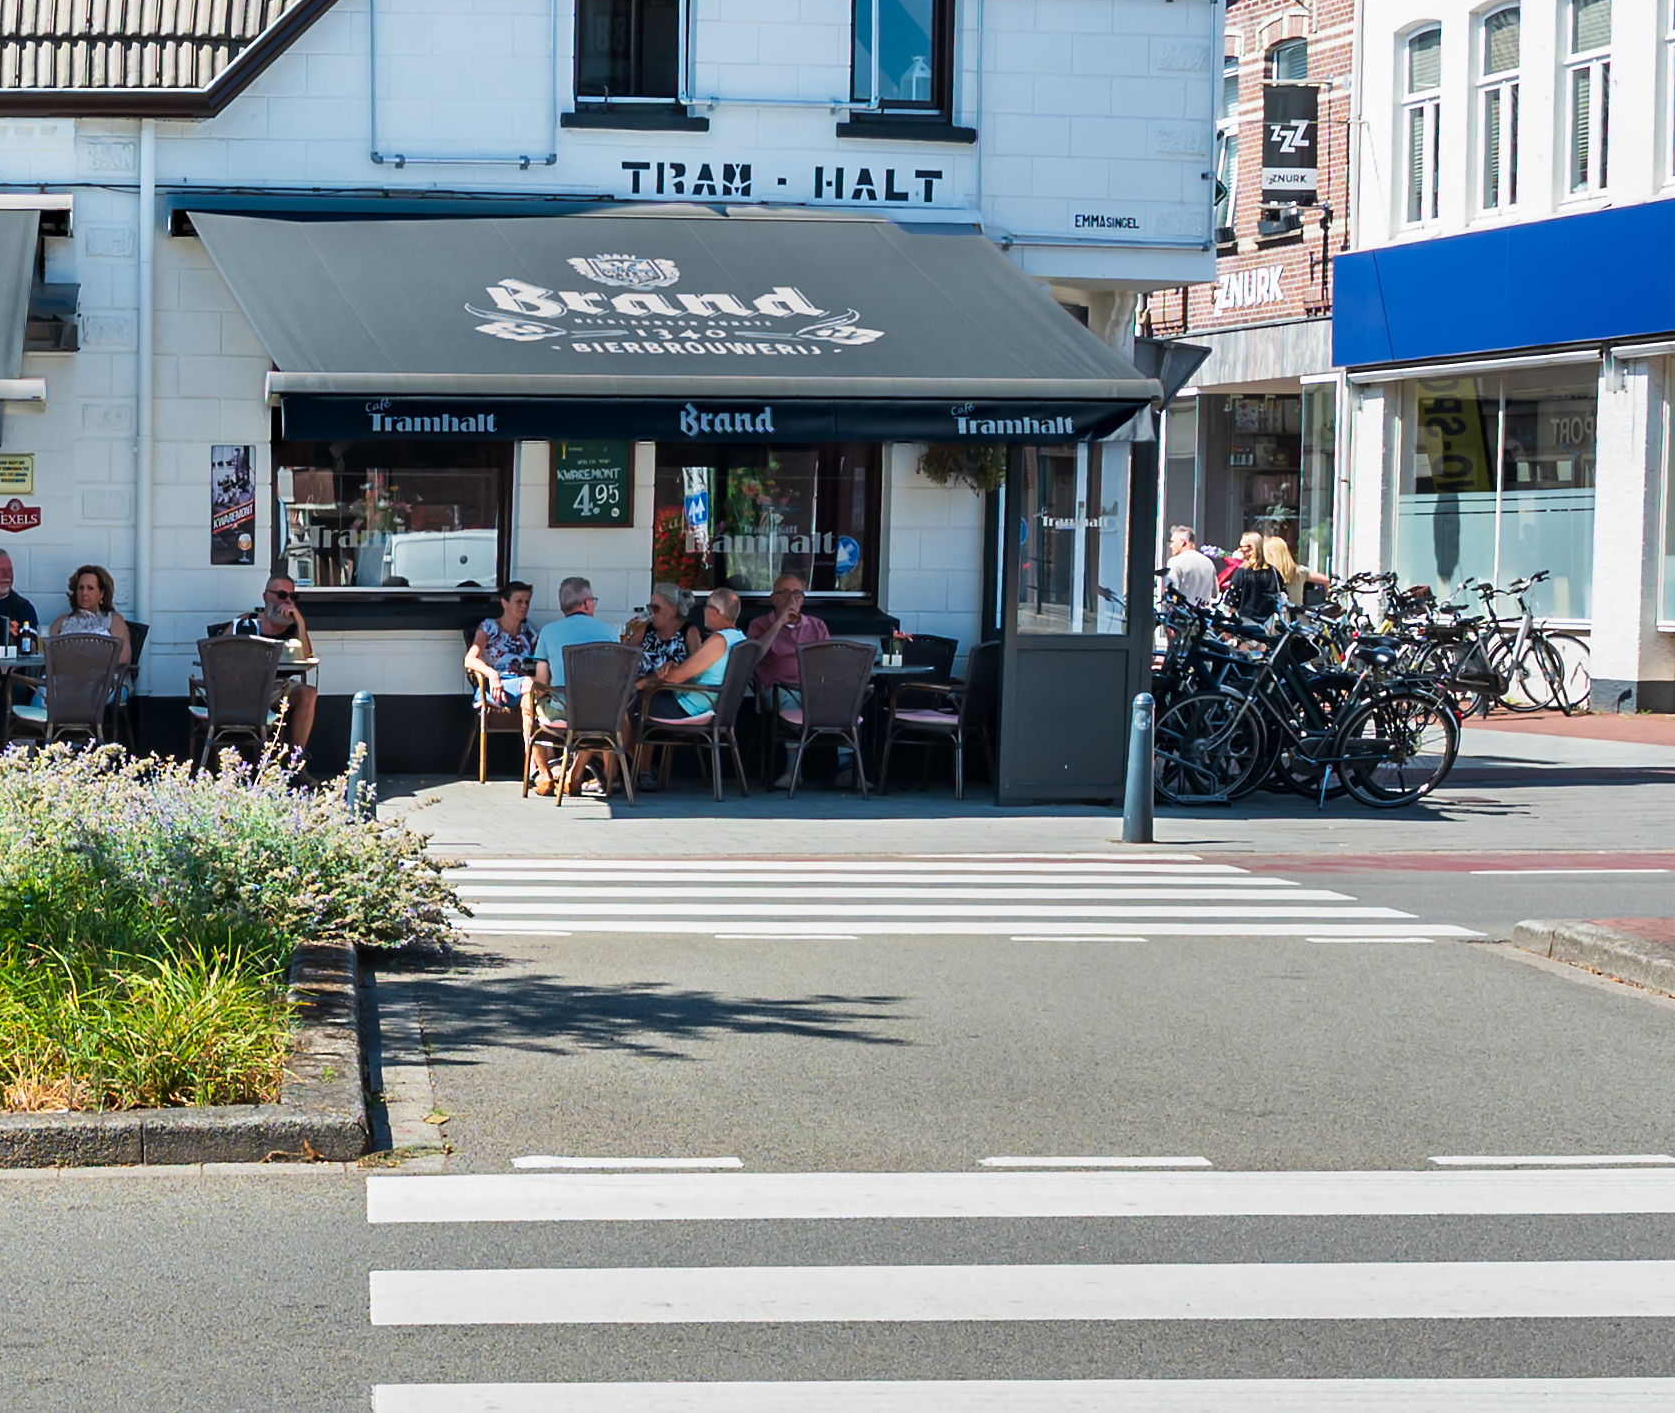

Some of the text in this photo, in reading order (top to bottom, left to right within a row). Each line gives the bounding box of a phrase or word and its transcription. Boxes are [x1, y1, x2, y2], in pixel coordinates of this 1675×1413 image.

[621, 161, 943, 203] TRAM HALT
[1074, 214, 1140, 229] EMMASINGEL
[485, 278, 830, 319] Brand
[635, 329, 729, 340] 1340
[571, 342, 823, 356] BIERBROUWERIJ
[368, 413, 498, 432] Tramhalt
[679, 403, 776, 438] Brand
[953, 416, 1077, 435] Tramhalt
[556, 467, 622, 481] KWAREMONT
[213, 503, 253, 530] KWAREMONT
